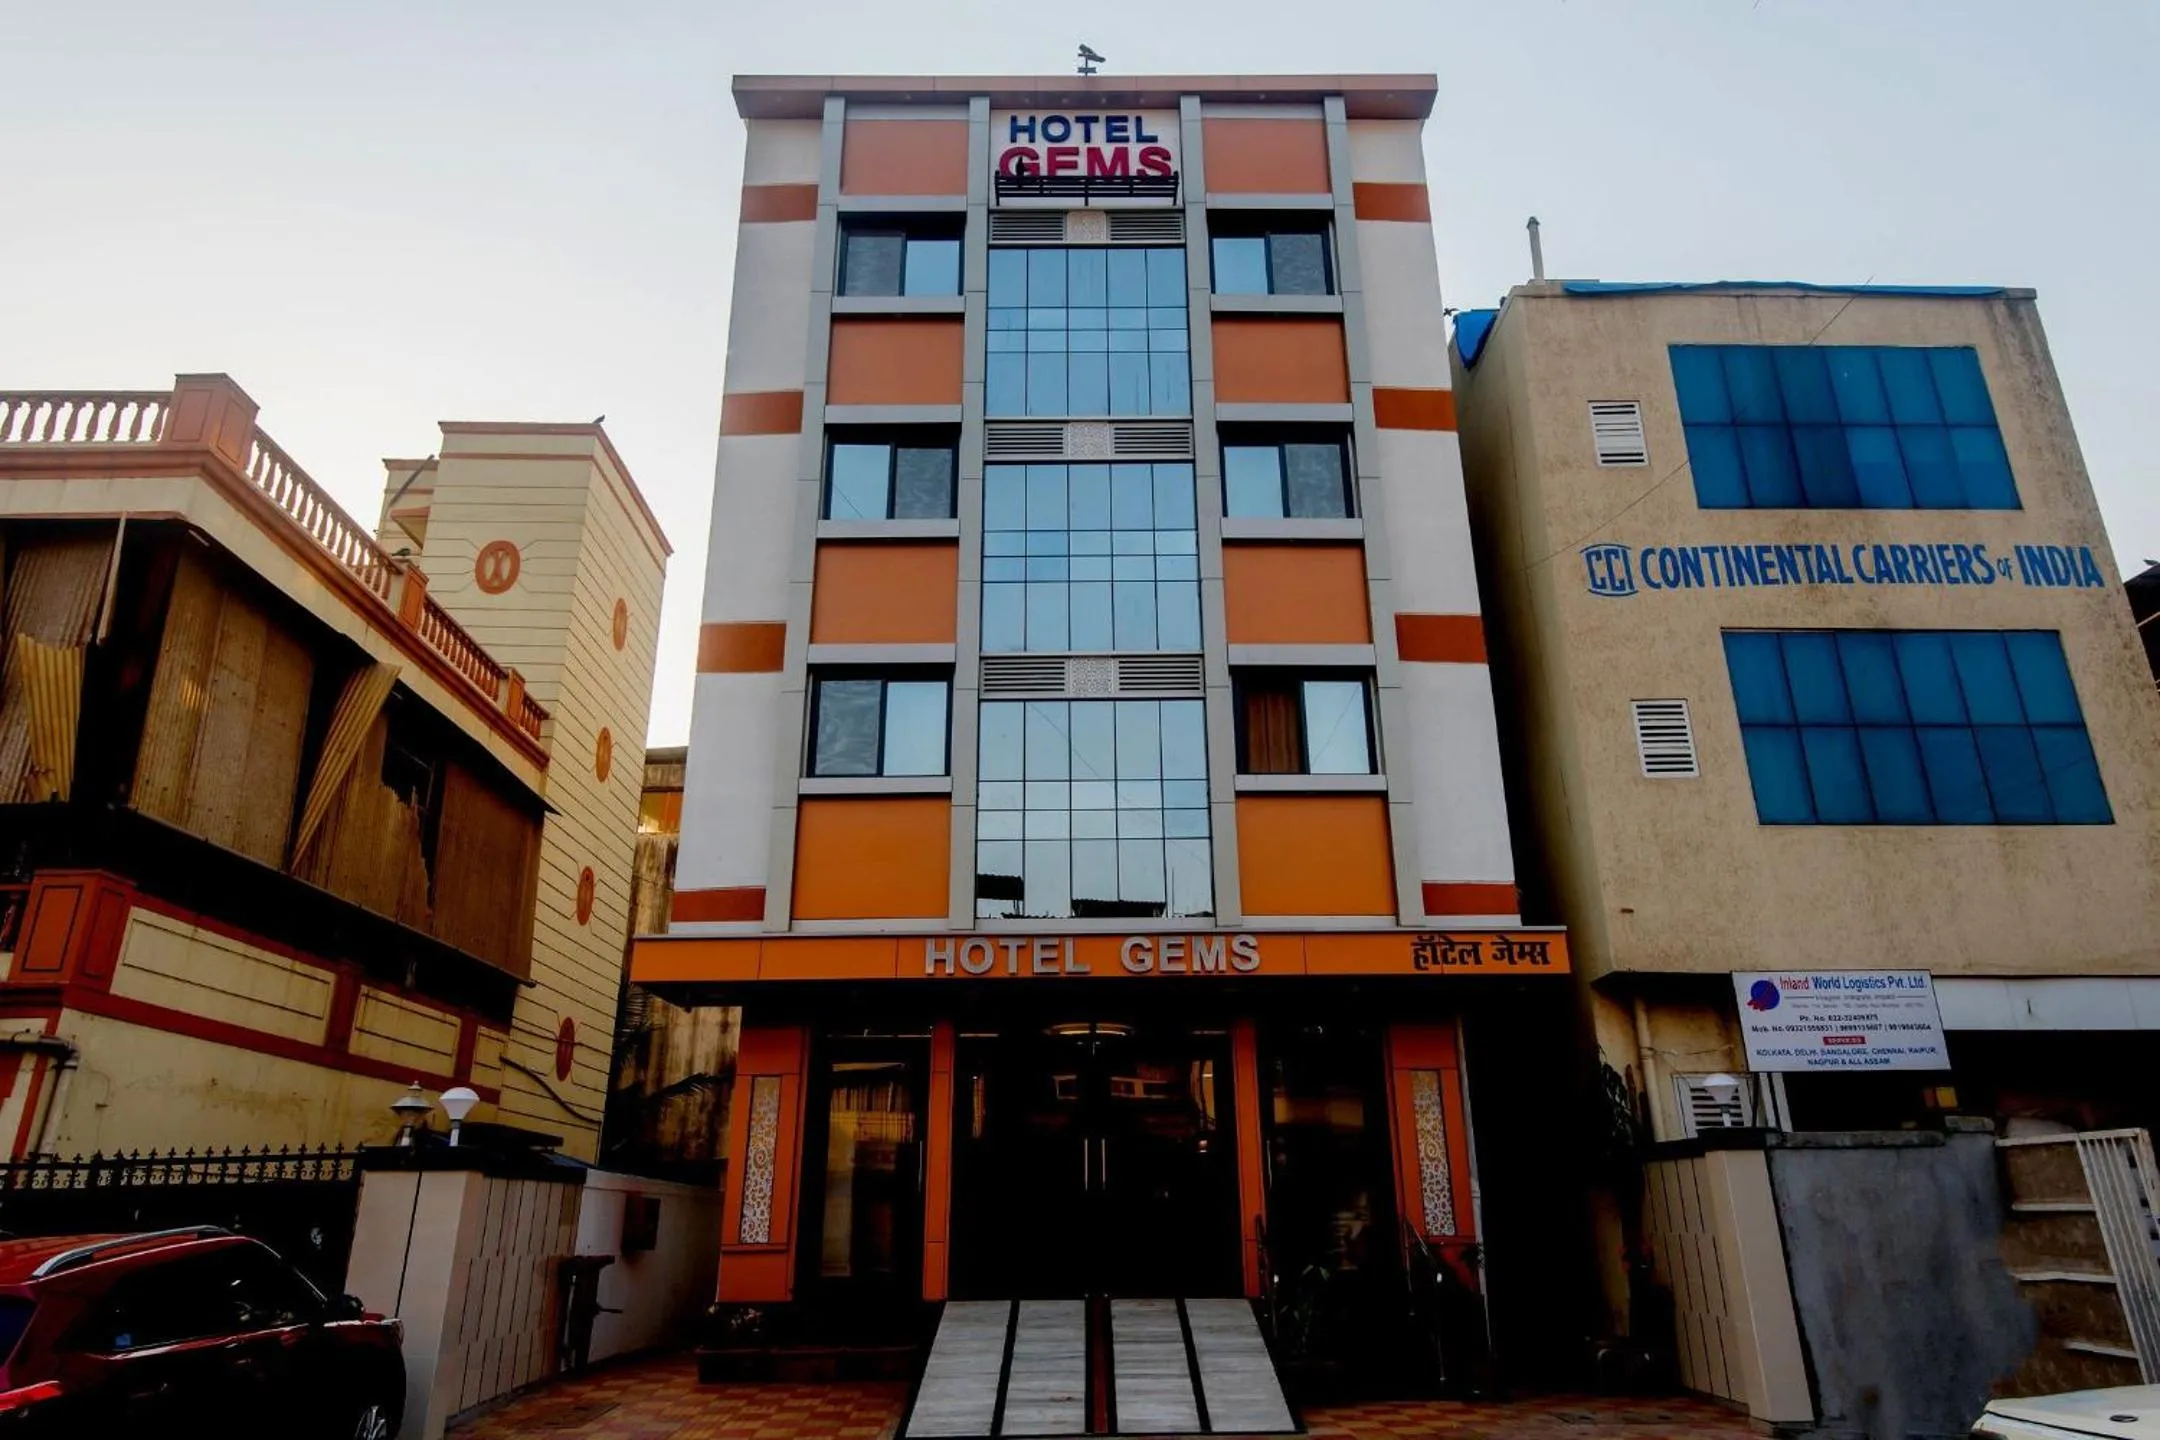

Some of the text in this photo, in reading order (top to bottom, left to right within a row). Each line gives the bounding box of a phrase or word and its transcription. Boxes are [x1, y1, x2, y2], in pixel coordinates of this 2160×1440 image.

[1009, 114, 1158, 144] HOTEL
[998, 146, 1173, 182] GEMS
[1586, 549, 1636, 592] CCI
[1640, 544, 1854, 589] CONTINENTAL
[1855, 543, 1996, 585] CARRIERS
[2014, 544, 2105, 588] INDIA
[925, 934, 1261, 975] HOTEL GEMS
[1410, 934, 1551, 971] हॉटेल जेम्स
[1780, 975, 1927, 992] Inland World Logistics Pvt. Ltd.
[1864, 1057, 1891, 1065] ASSAM
